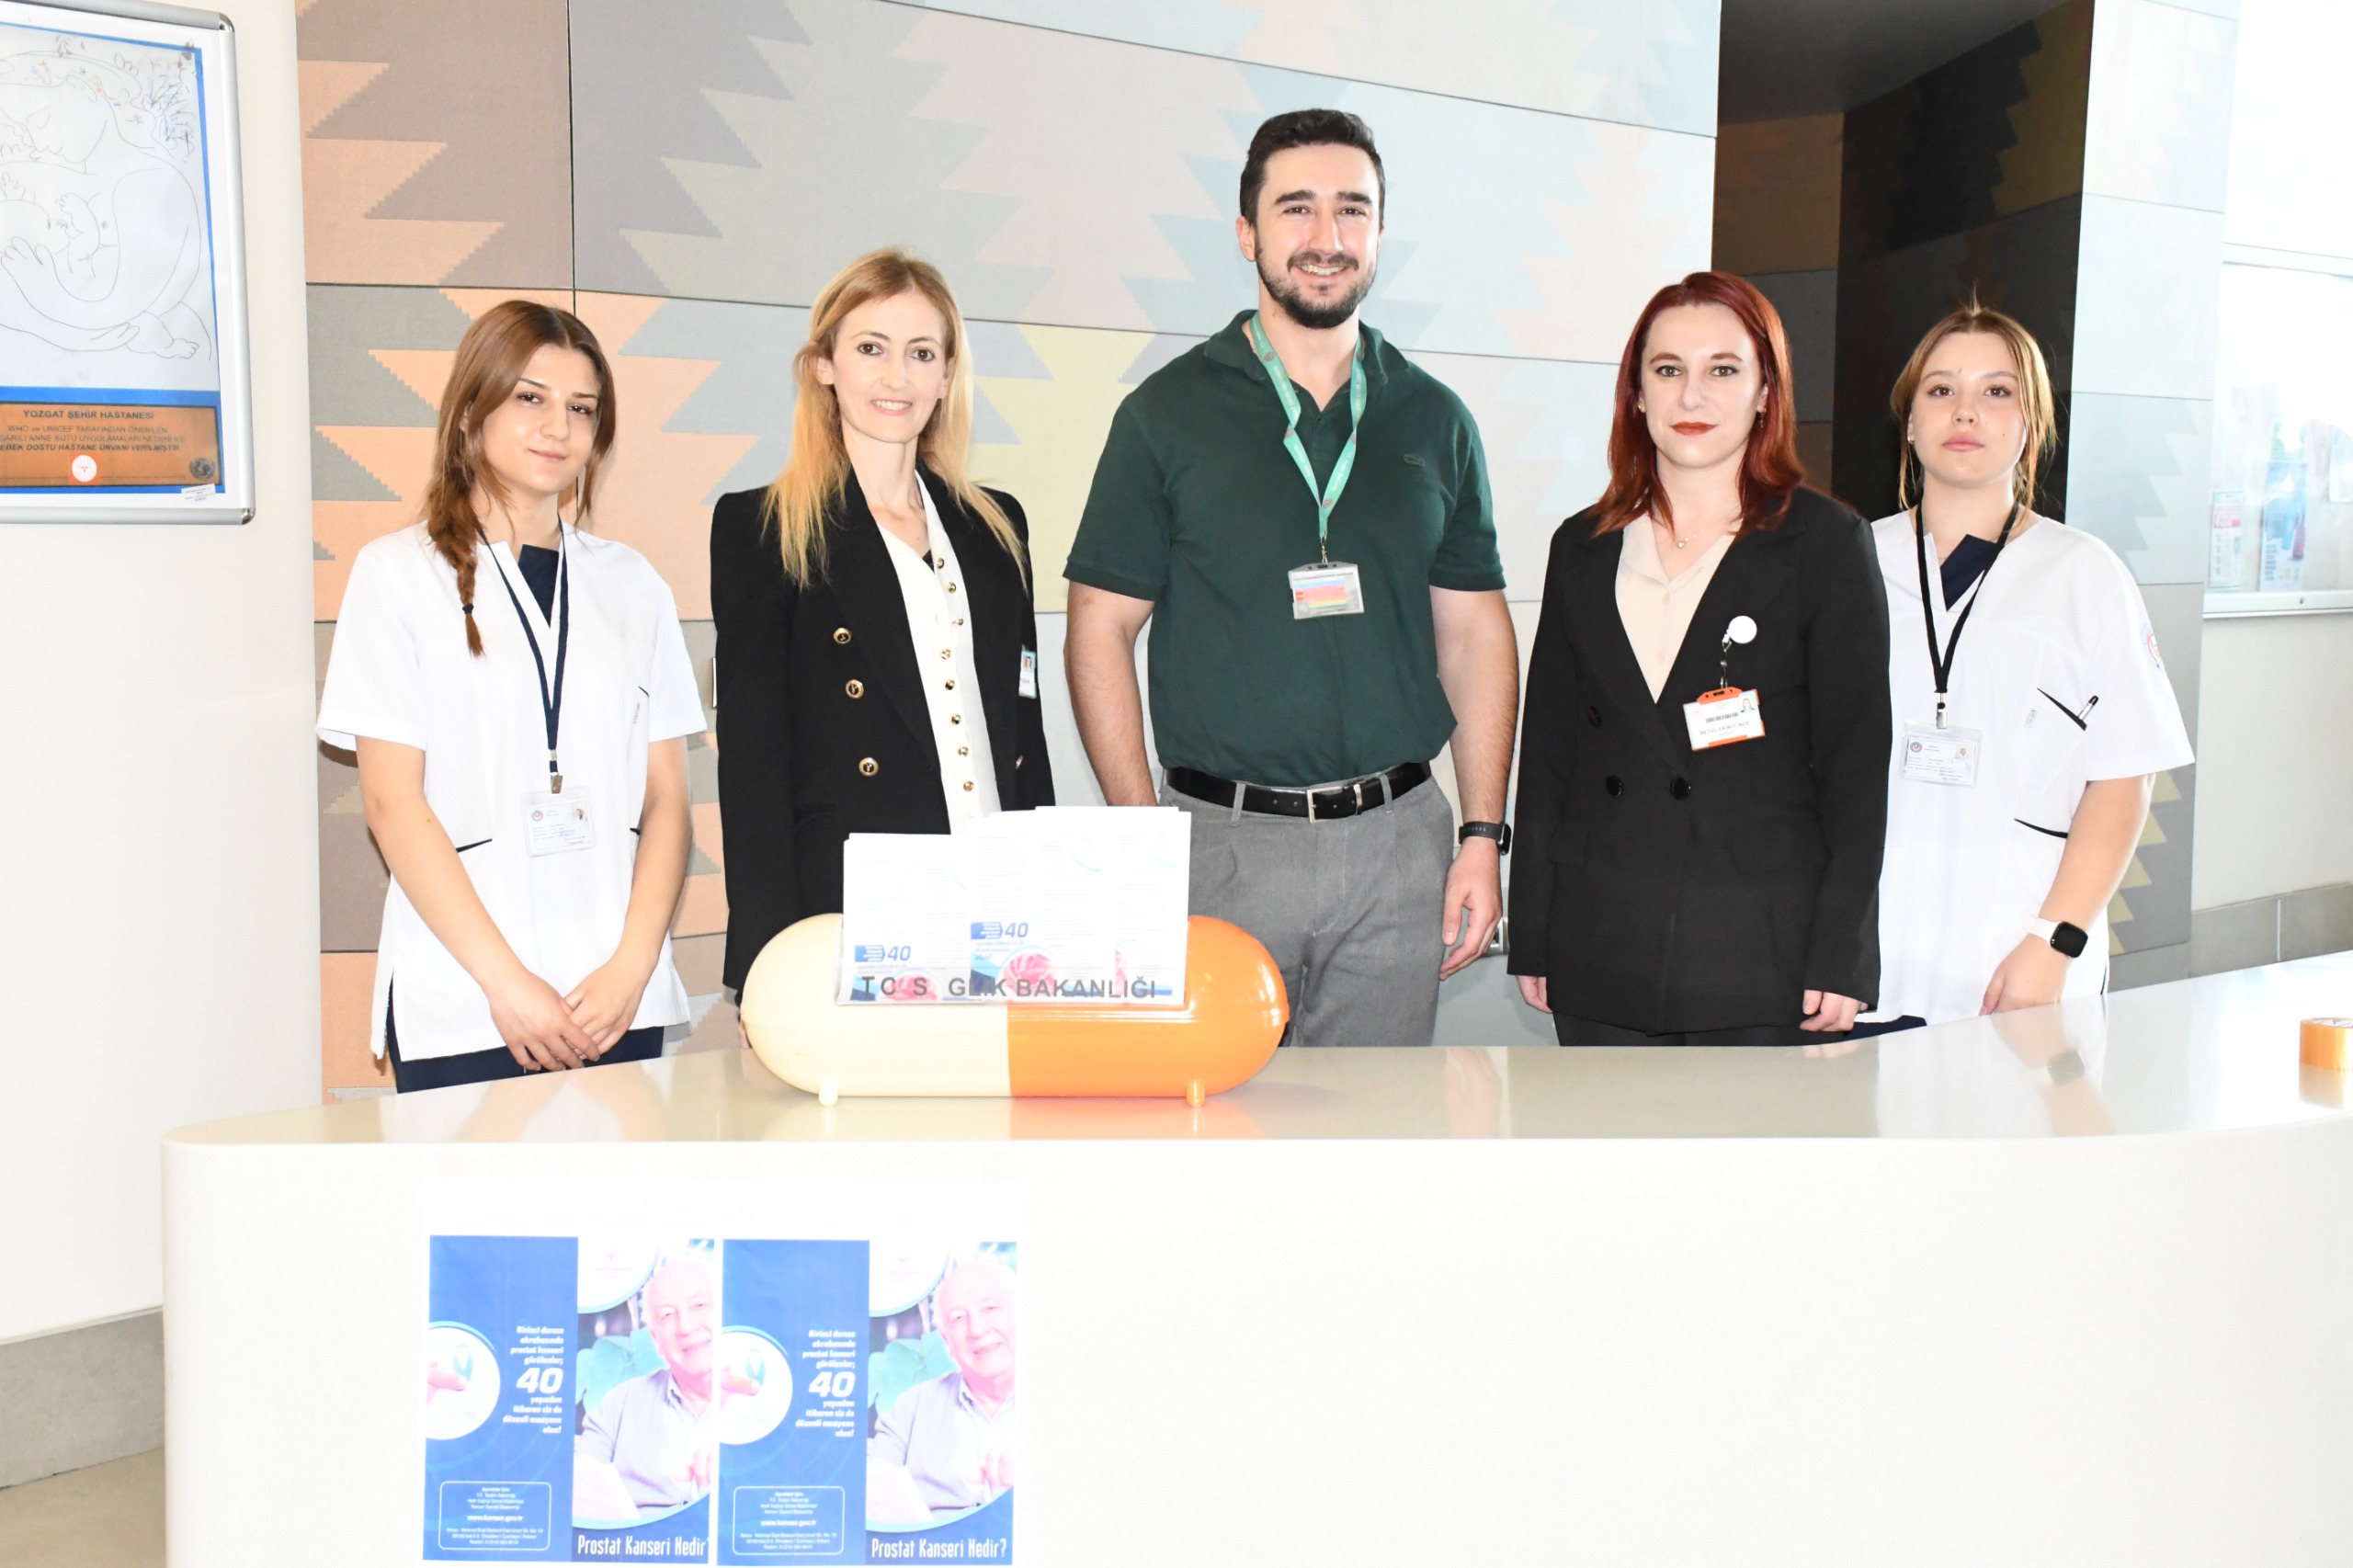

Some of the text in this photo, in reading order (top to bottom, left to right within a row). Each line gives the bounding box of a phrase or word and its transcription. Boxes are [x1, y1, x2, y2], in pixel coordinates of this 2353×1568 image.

[23, 410, 153, 420] YOZGAT ŞEHİR HASTANESİ
[26, 443, 56, 451] DOSTU
[58, 443, 97, 451] HASTANE
[1006, 922, 1029, 938] 40
[887, 945, 912, 961] 40
[1017, 975, 1155, 999] BAKANLIĞI
[516, 1367, 564, 1394] 40
[808, 1370, 857, 1398] 40
[578, 1534, 709, 1556] Prostat Kanseri Nedir
[871, 1538, 1007, 1559] Prostat Kanseri Nedir?
